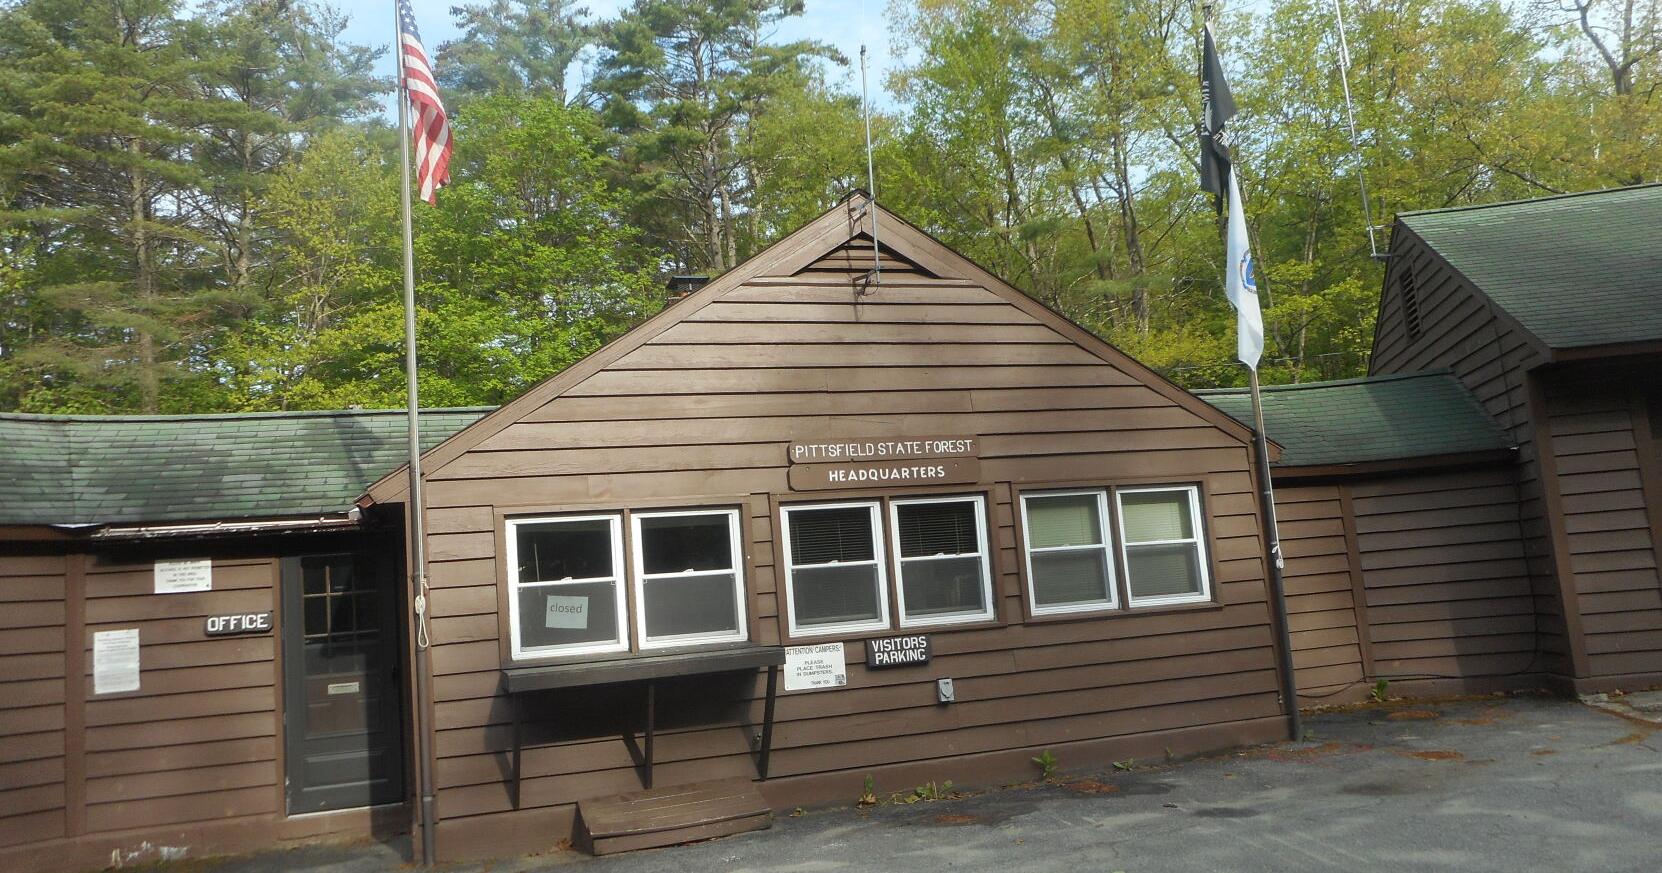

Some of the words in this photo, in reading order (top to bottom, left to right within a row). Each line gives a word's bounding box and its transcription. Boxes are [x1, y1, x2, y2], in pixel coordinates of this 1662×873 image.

[795, 443, 875, 459] PITTSFIELD
[878, 441, 922, 455] STATE
[925, 439, 973, 453] FOREST
[828, 465, 945, 482] HEADQUARTERS
[550, 602, 583, 614] closed
[207, 613, 269, 632] OFFICE
[871, 636, 927, 652] VISITORS
[875, 648, 926, 665] PARKING
